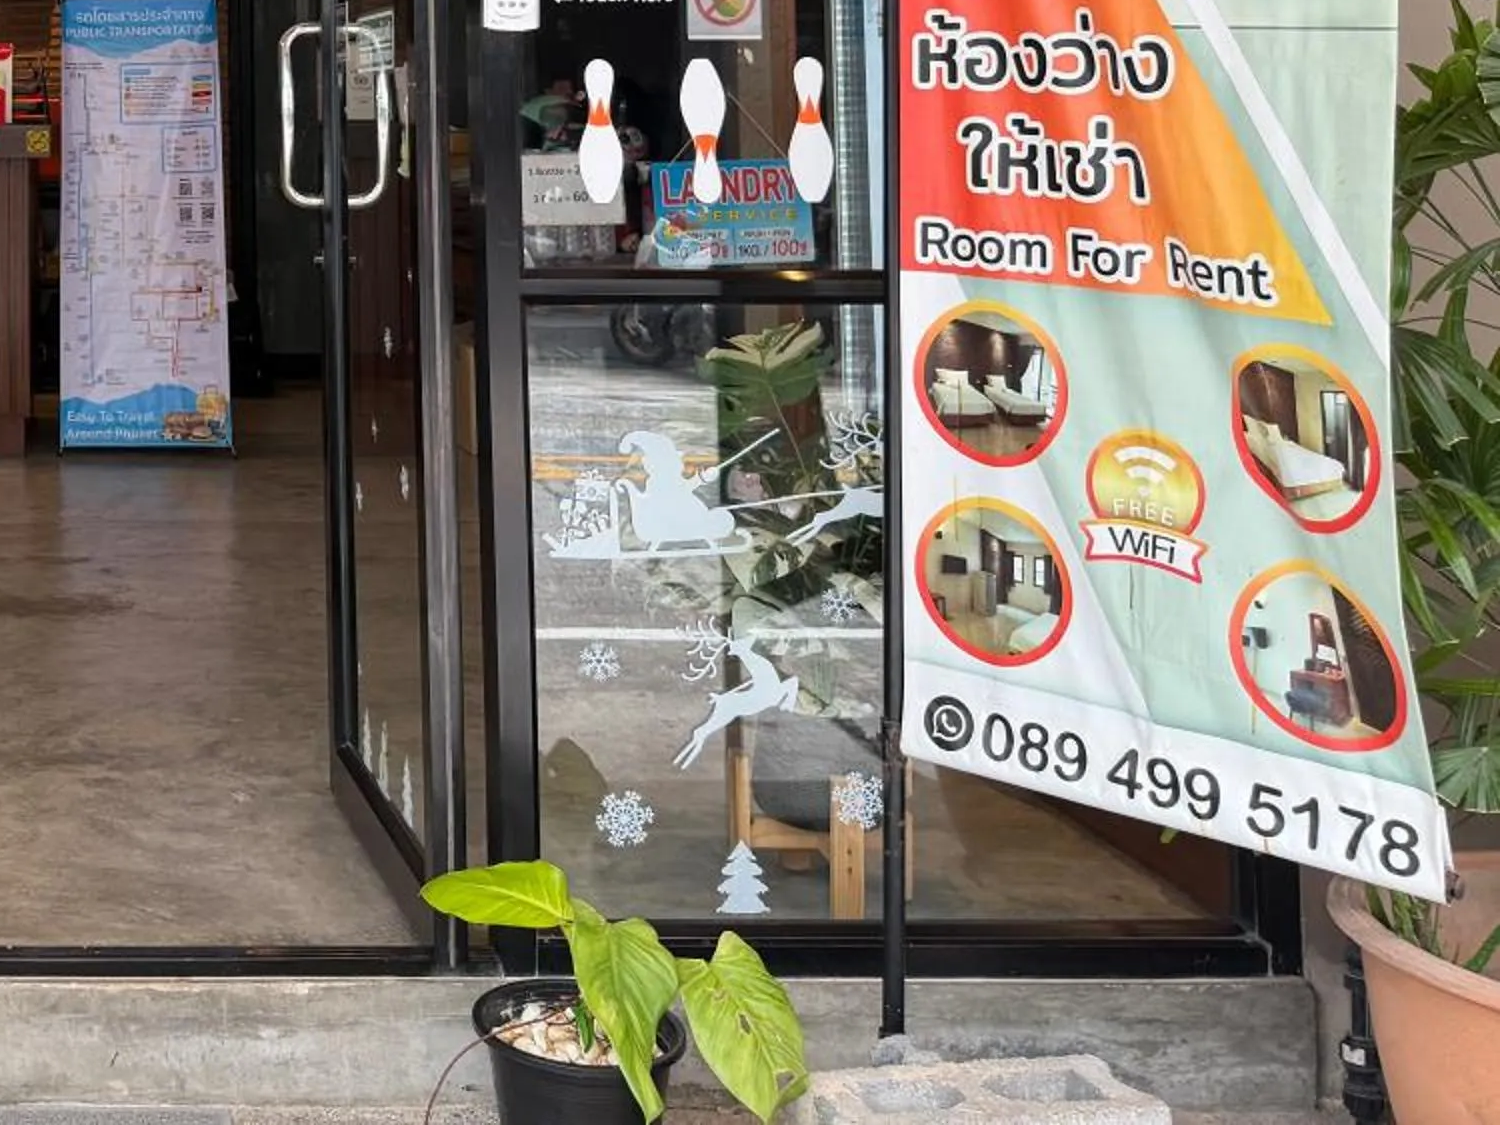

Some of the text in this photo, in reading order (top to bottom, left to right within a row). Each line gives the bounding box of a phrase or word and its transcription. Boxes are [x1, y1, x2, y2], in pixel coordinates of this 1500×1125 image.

[65, 23, 214, 39] PUBLIC TRANSPORTATION
[917, 11, 1170, 95] ห้องว่าง
[960, 118, 1147, 199] ให้เช่า
[661, 166, 799, 207] LANDRY
[918, 221, 1273, 301] Room For Rent
[100, 410, 115, 422] To
[1112, 498, 1175, 527] FREE
[1107, 526, 1177, 565] WiFi
[981, 711, 1422, 878] 089 499 5178
